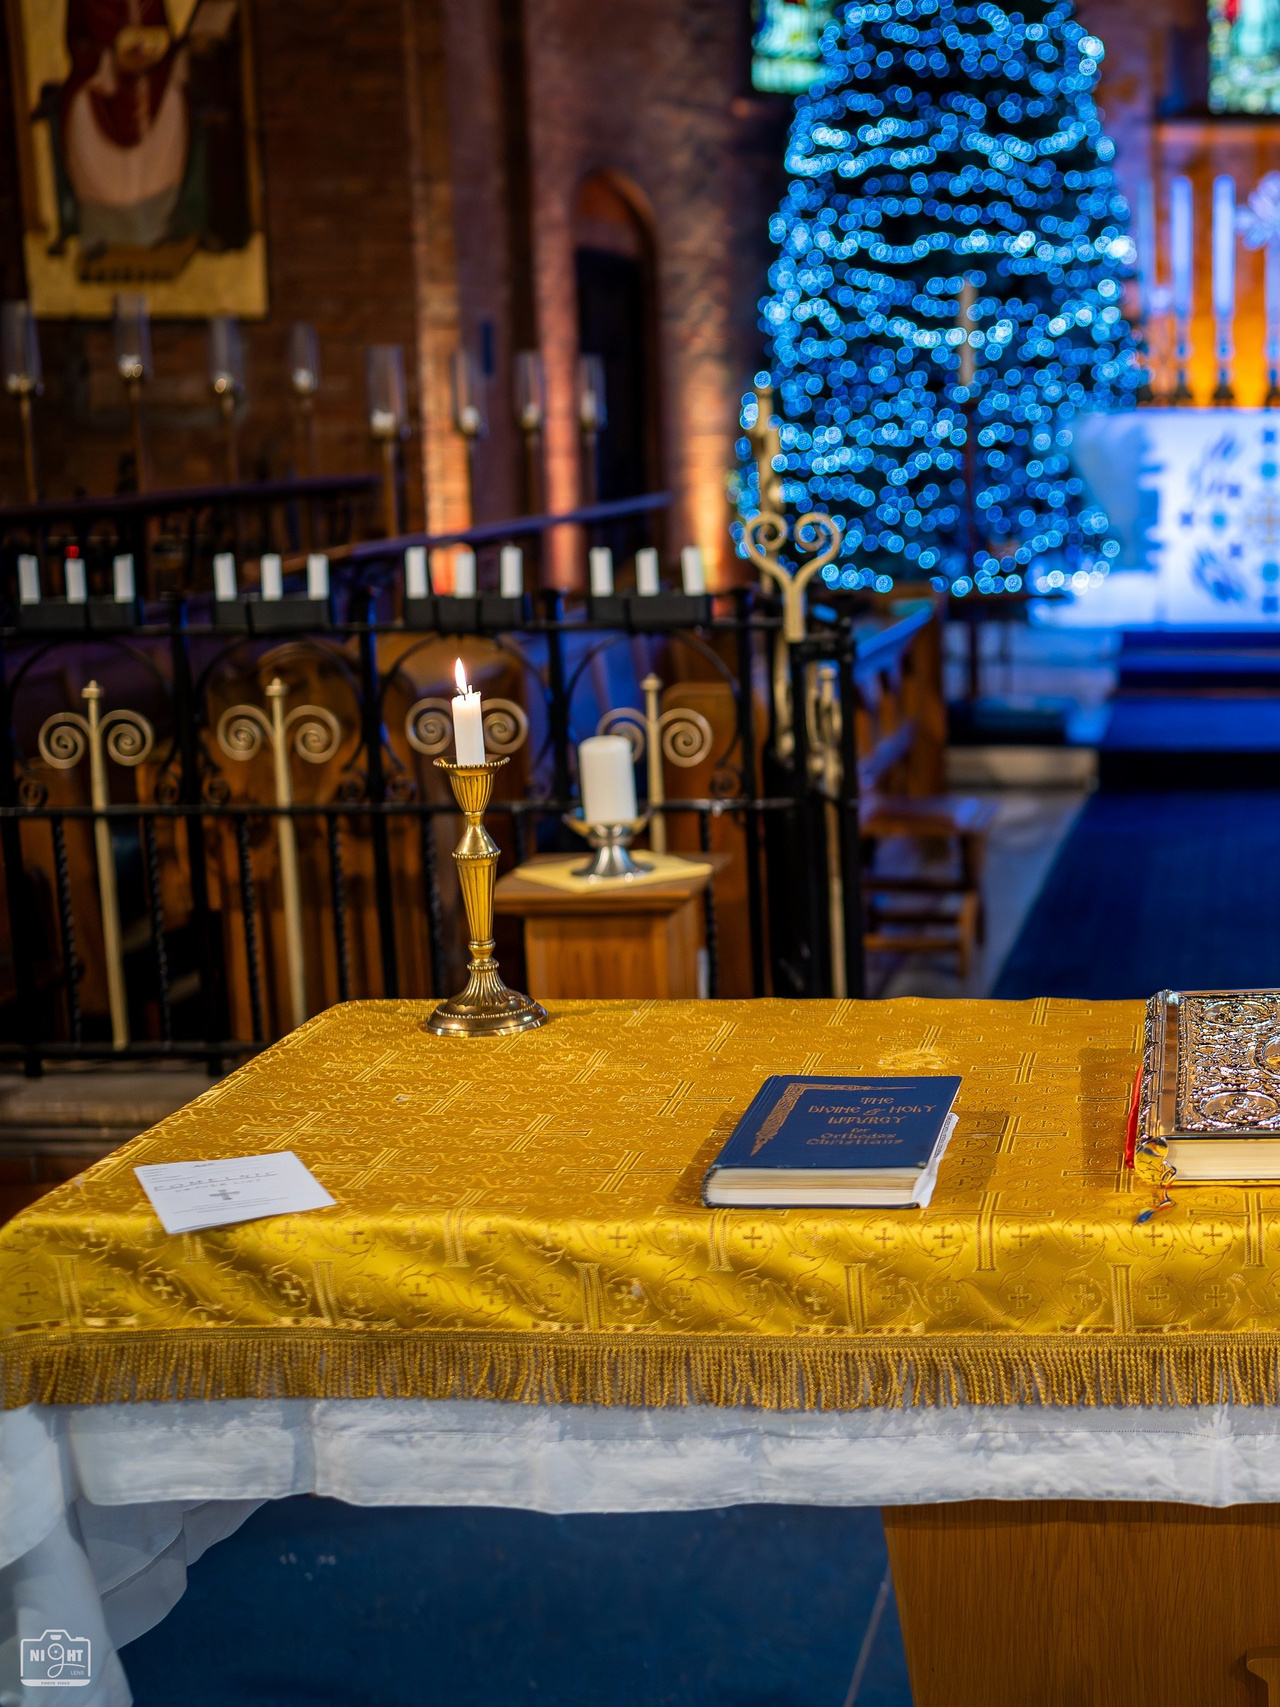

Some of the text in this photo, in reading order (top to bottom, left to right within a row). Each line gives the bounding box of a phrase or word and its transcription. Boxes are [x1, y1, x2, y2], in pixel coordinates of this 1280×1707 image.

[860, 1096, 895, 1105] THE
[808, 1105, 861, 1114] DIVINE
[888, 1104, 937, 1113] HOLY
[827, 1115, 907, 1124] LITURGY
[820, 1132, 897, 1140] Orthodox
